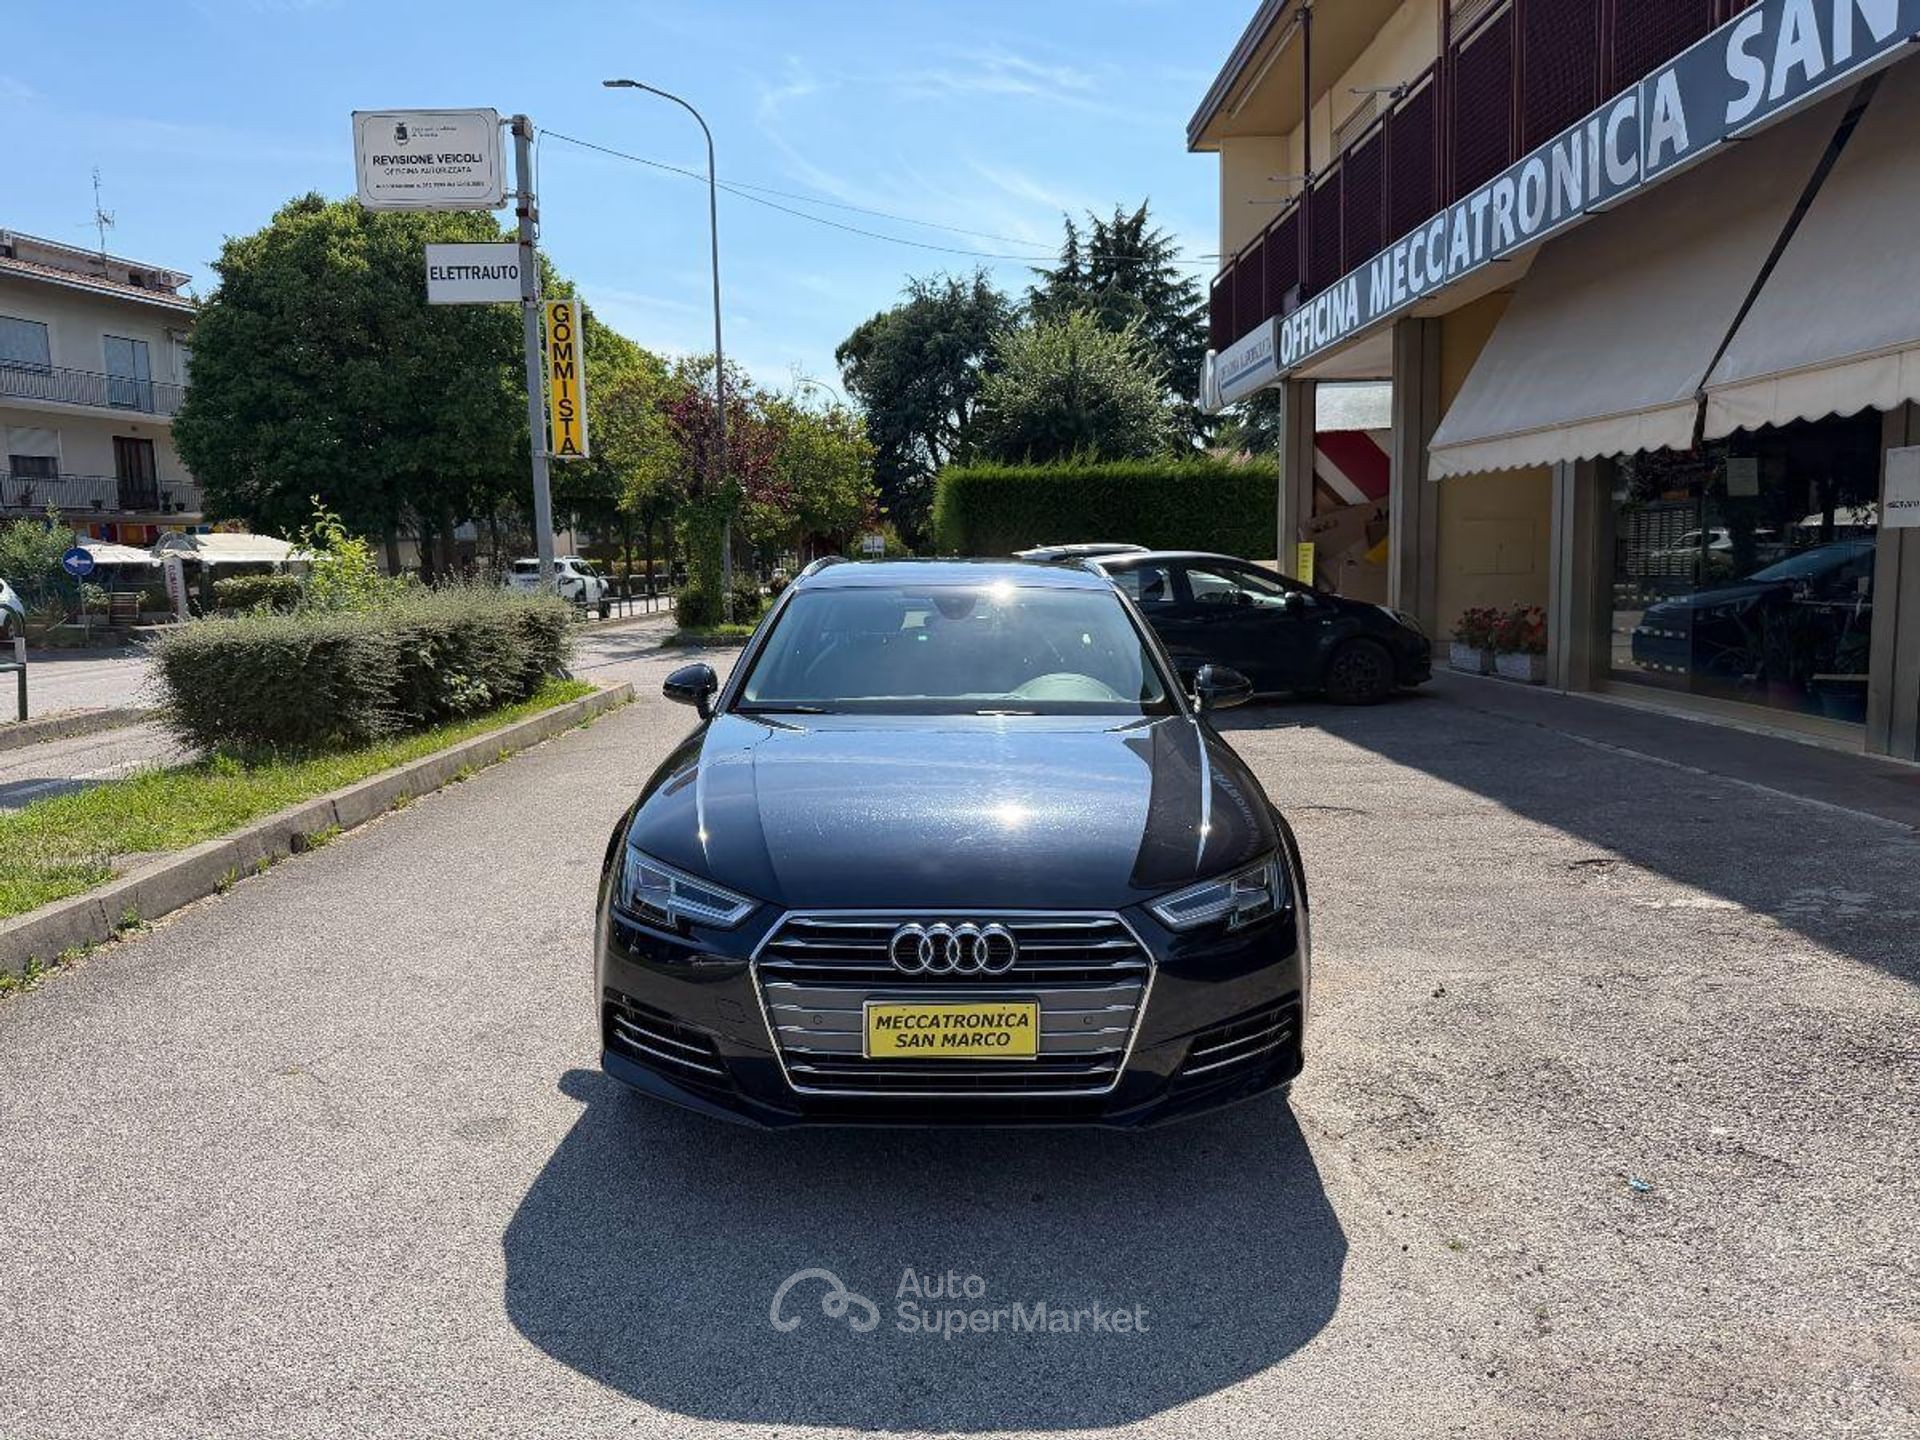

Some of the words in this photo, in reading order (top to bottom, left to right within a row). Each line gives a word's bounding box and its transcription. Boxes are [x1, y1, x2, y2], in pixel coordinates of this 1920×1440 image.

[373, 154, 434, 166] REVISIONE
[437, 153, 483, 164] VEICOLI
[1280, 277, 1360, 365] OFFICINA
[1369, 68, 1689, 317] MECCATRONICA
[430, 265, 518, 280] ELETTRAUTO
[552, 304, 577, 455] GOMMISTA
[876, 1013, 1029, 1030] MECCATRONICA
[896, 1033, 936, 1048] SAN
[941, 1032, 1011, 1047] MARCO
